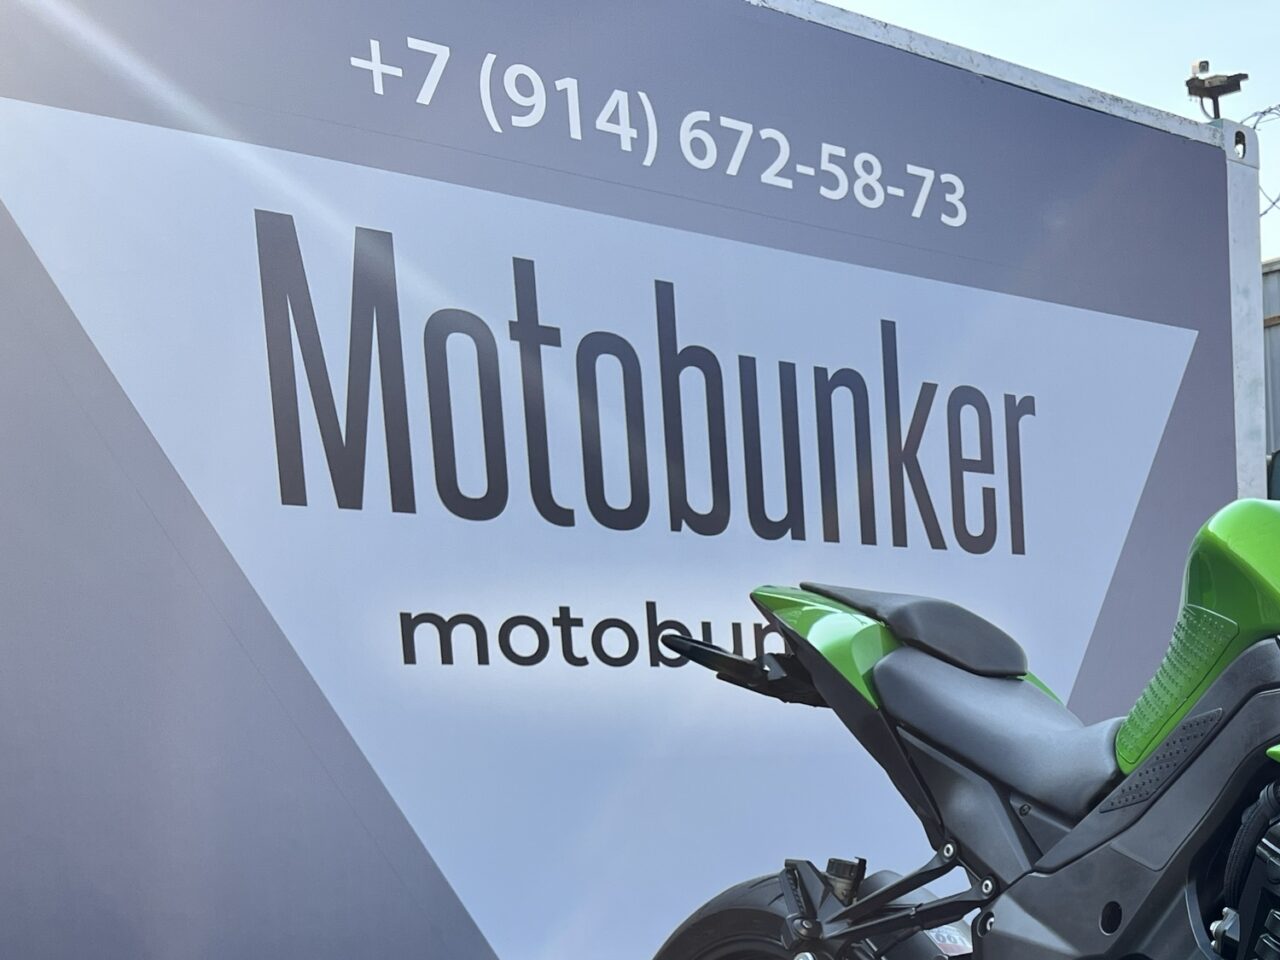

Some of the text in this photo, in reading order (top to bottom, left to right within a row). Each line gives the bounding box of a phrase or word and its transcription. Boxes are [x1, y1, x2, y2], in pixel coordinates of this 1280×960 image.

[350, 37, 968, 228] +7 (914) 672-58-73
[254, 208, 1036, 556] Motobunker
